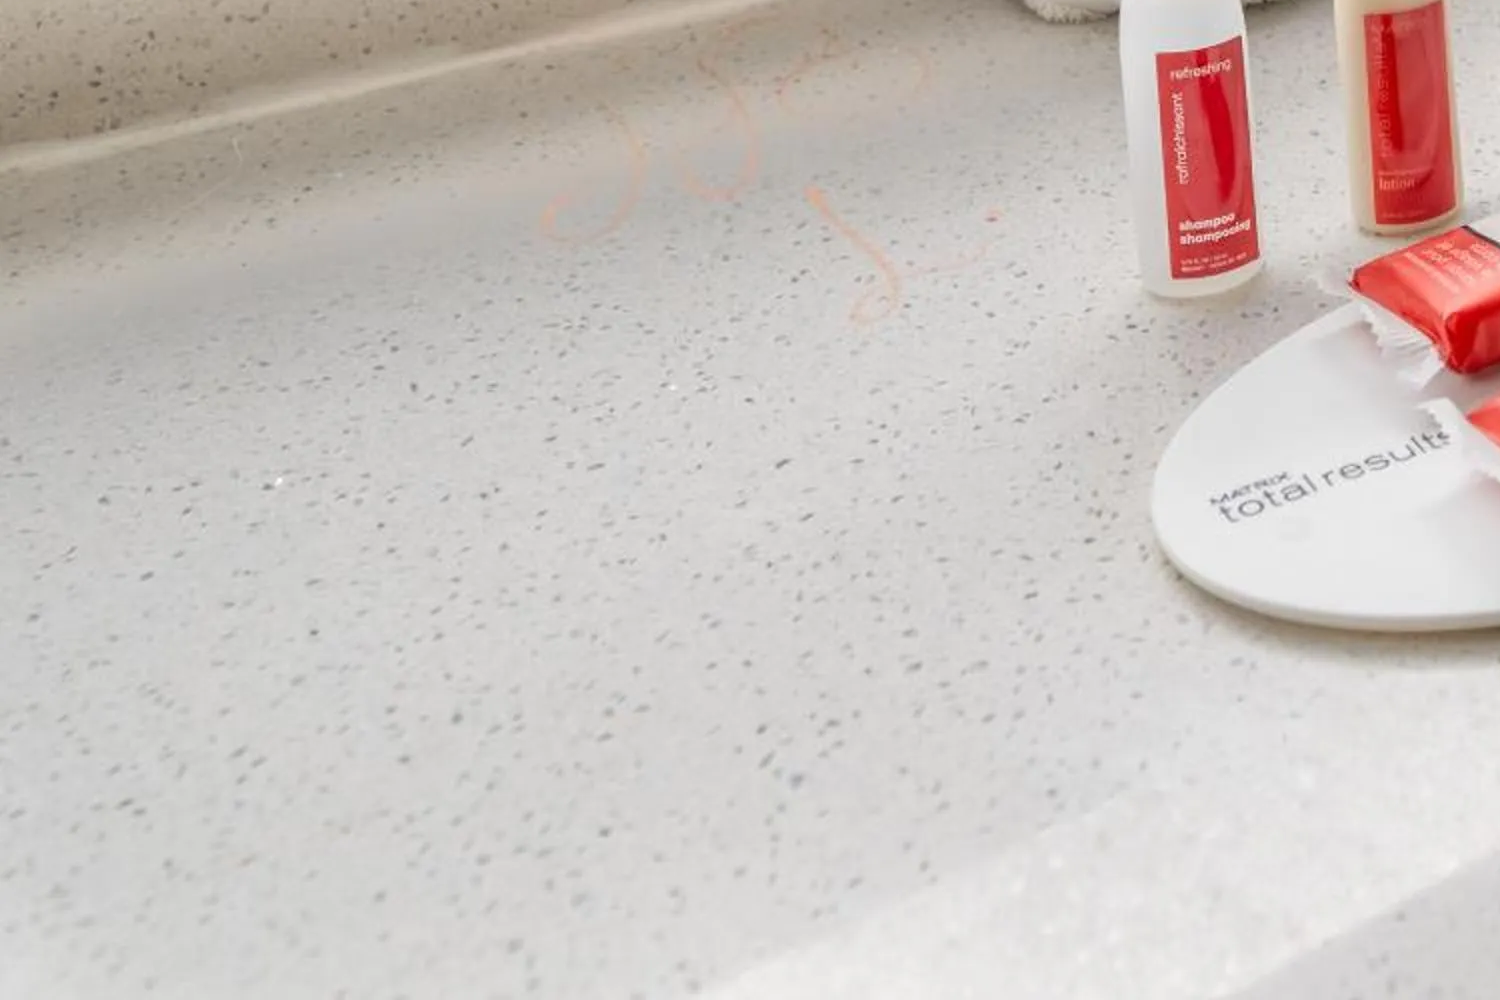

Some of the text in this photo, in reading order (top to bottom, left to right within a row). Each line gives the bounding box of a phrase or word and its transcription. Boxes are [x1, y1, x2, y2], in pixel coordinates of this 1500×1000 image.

[1169, 57, 1232, 81] refreshing
[1378, 175, 1416, 192] lotion
[1178, 212, 1236, 233] shampoo
[1179, 217, 1252, 246] shampooing
[1208, 471, 1291, 505] MATRIX
